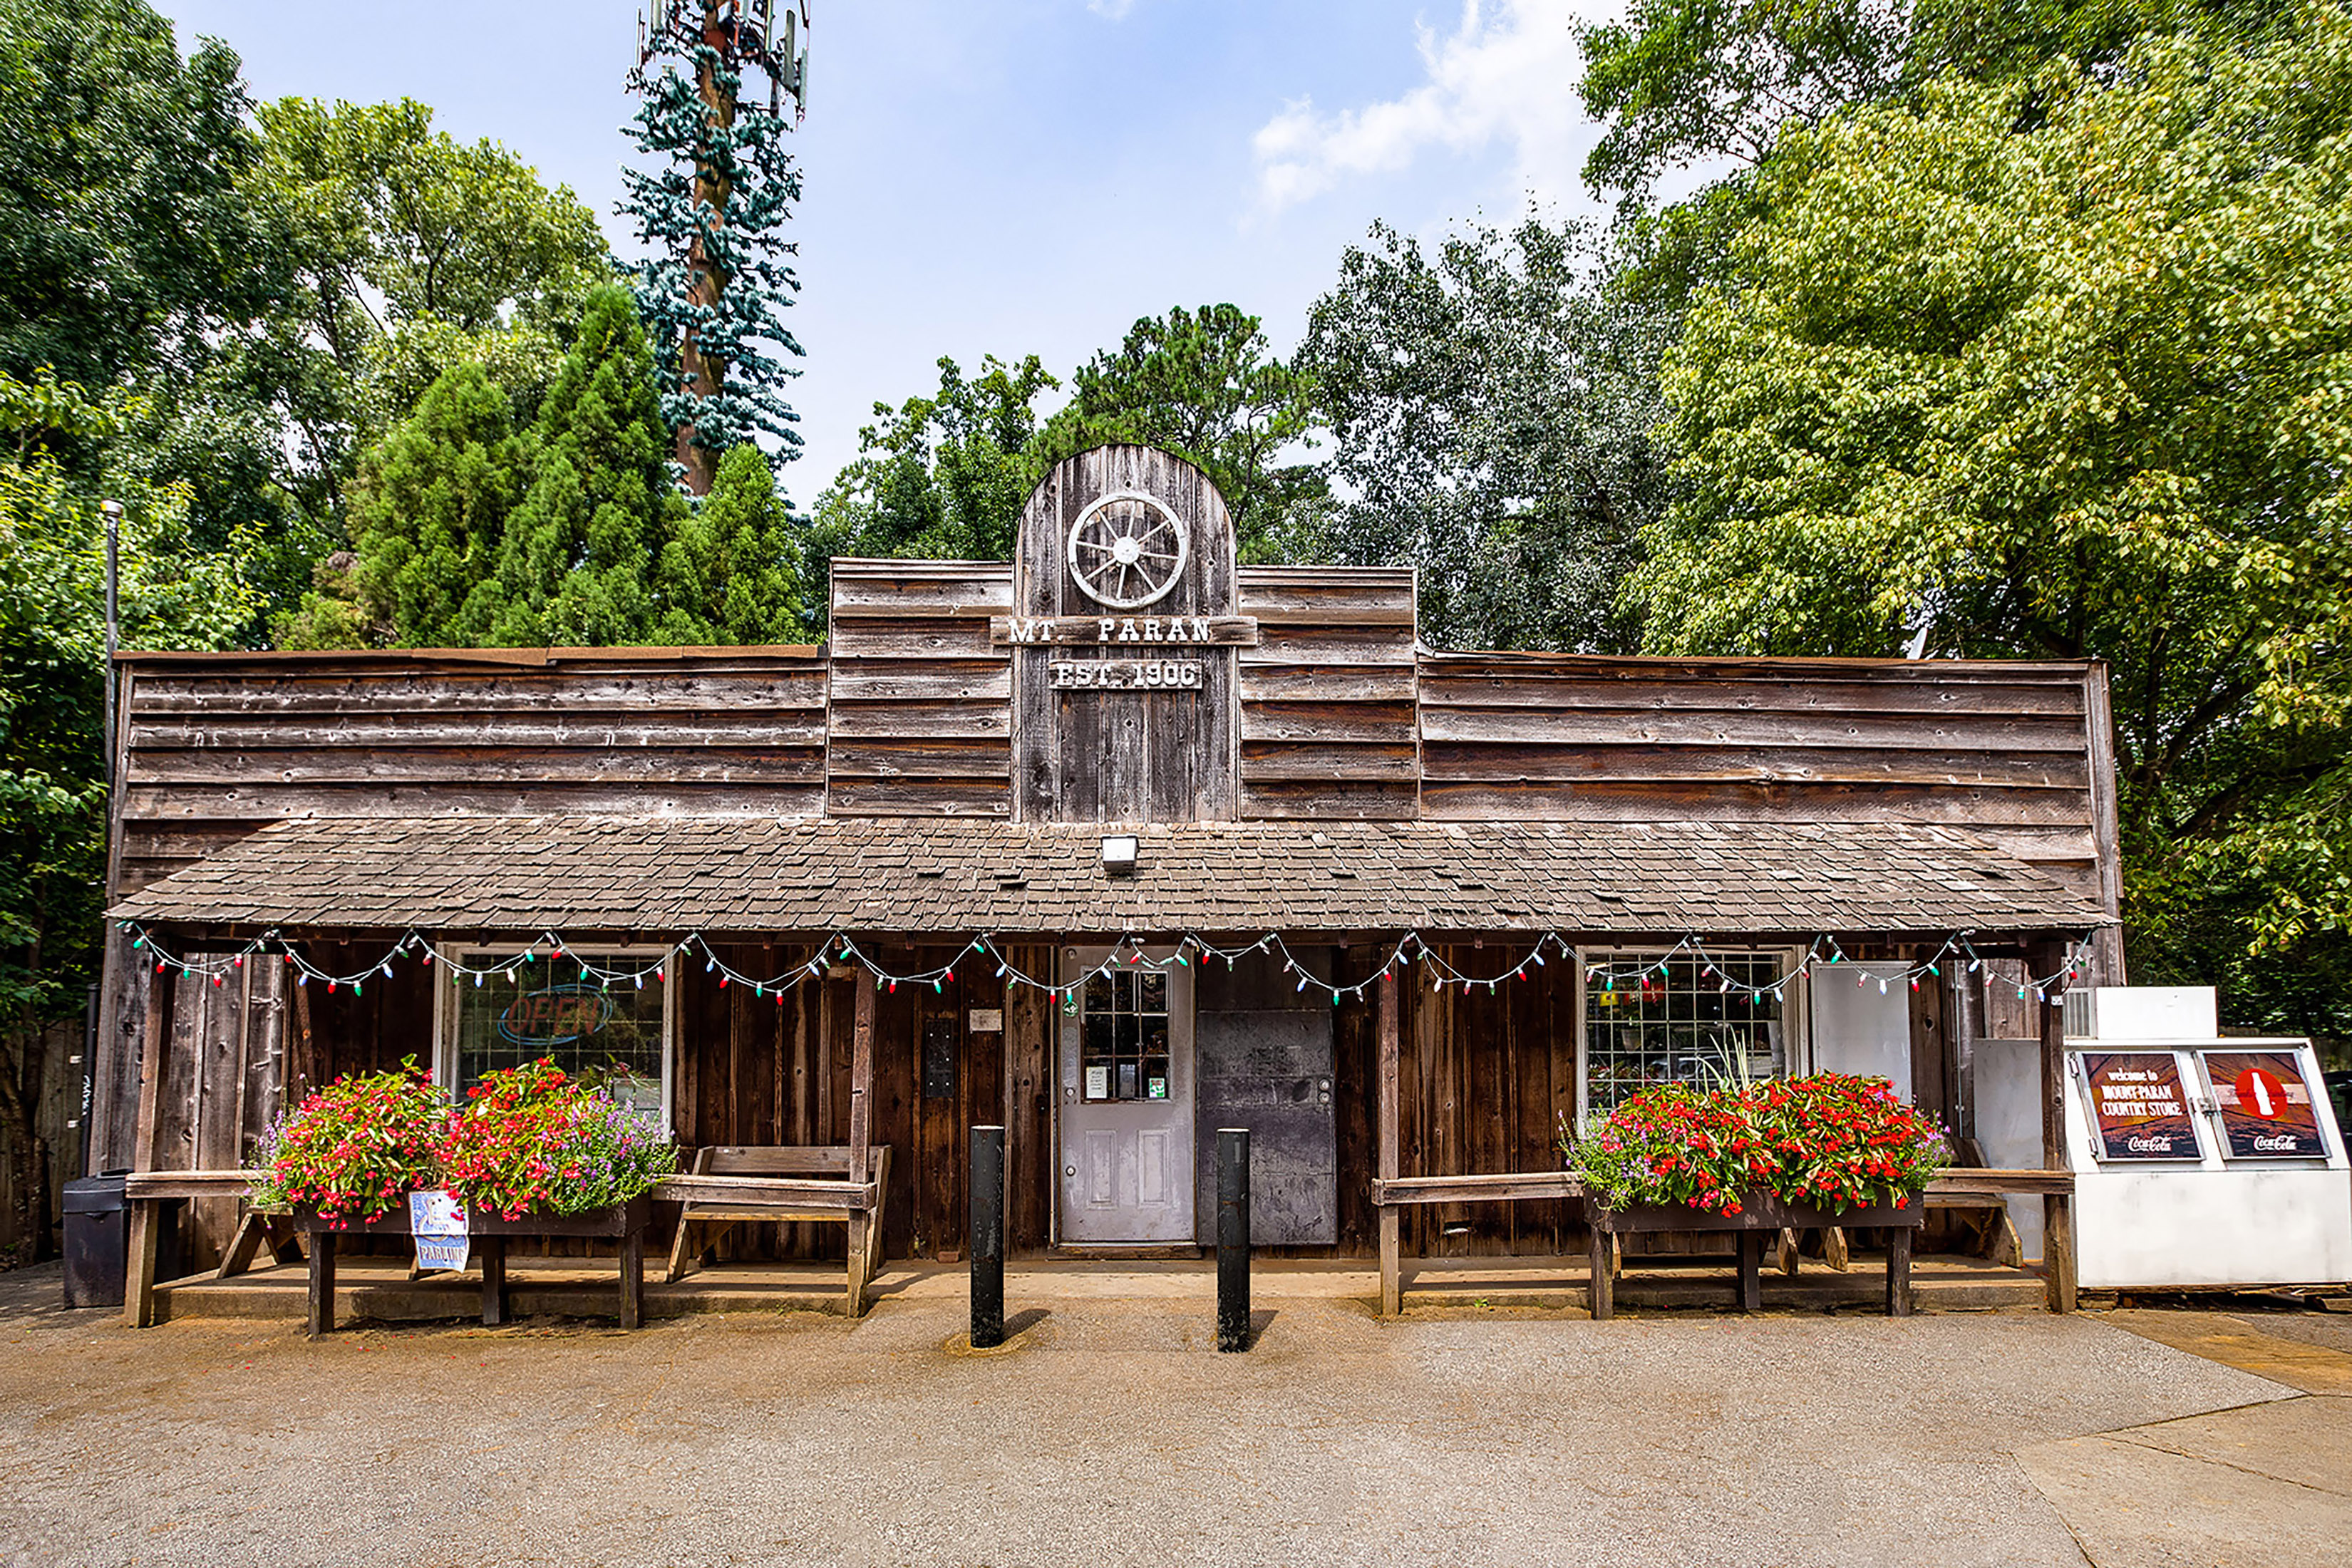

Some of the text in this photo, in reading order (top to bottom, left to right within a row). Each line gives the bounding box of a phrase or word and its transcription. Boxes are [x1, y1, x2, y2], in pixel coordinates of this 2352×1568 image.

[1008, 617, 1211, 642] MT. PARAN
[1132, 663, 1196, 687] 1906
[507, 996, 601, 1035] OPEN
[2107, 1067, 2158, 1081] welcome to
[2101, 1101, 2183, 1116] COUNTRY STORE
